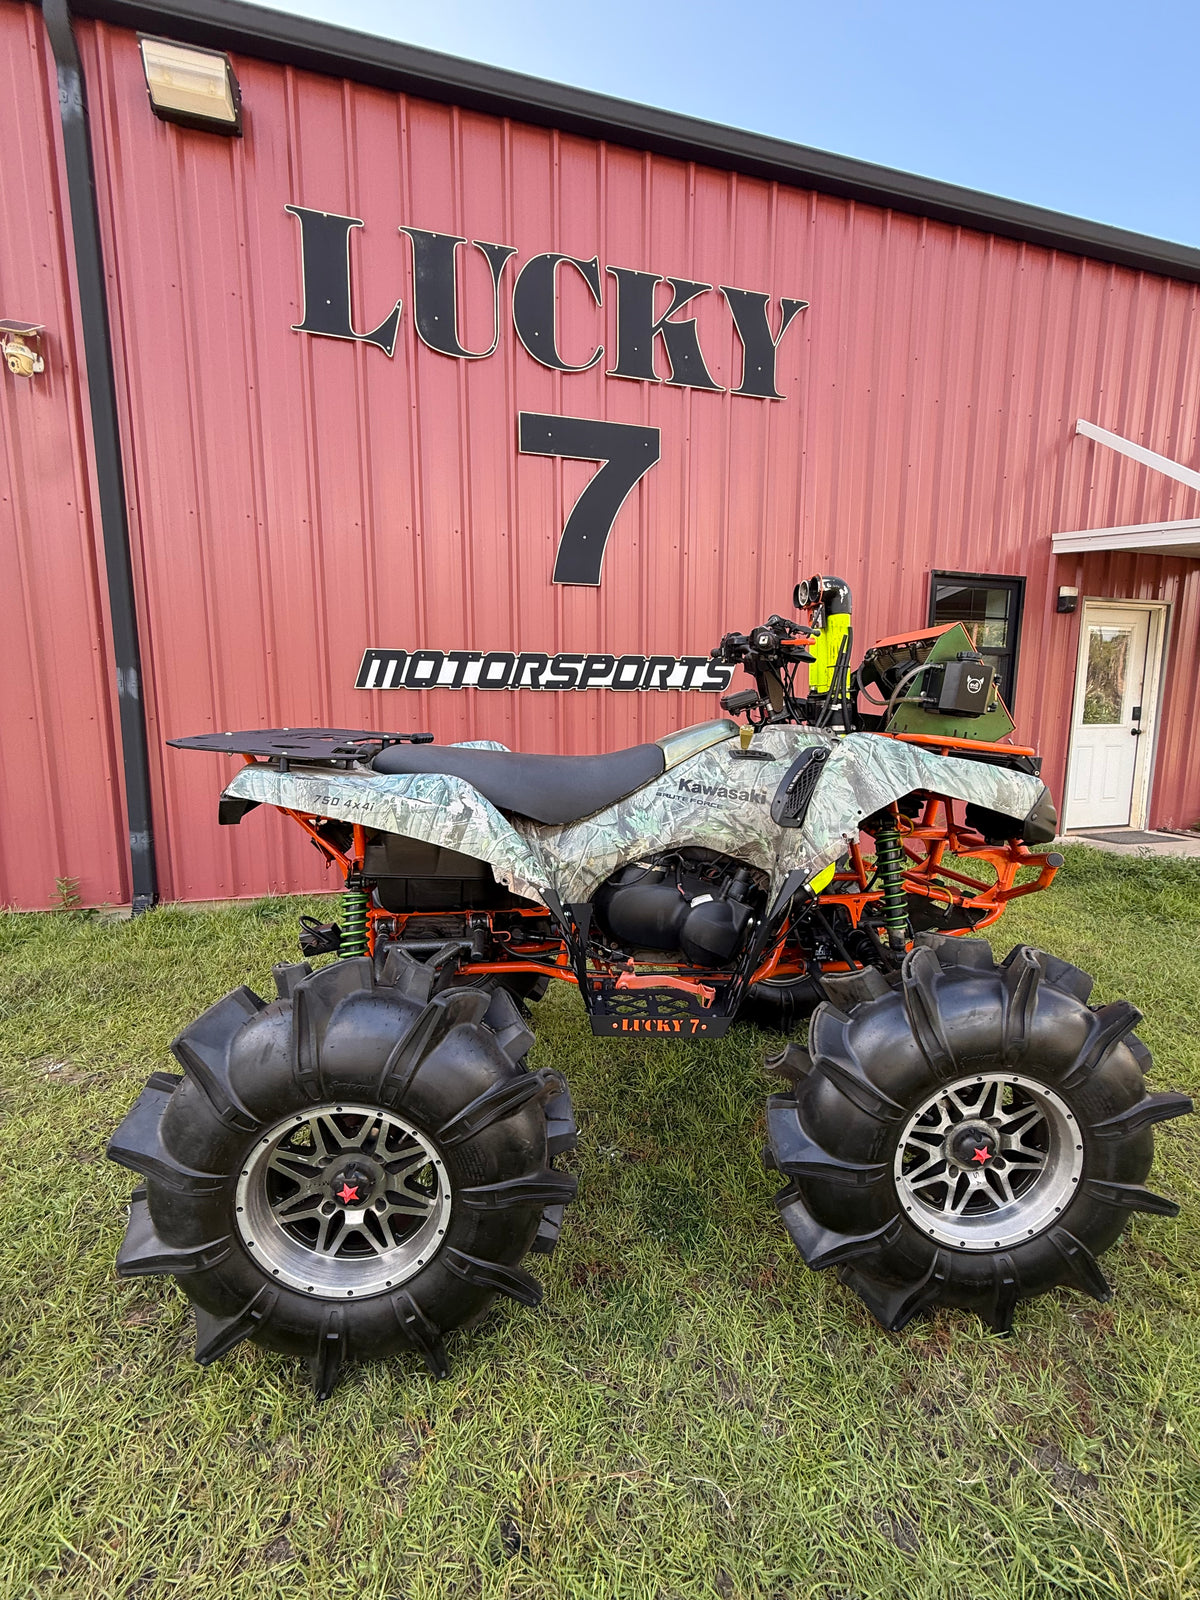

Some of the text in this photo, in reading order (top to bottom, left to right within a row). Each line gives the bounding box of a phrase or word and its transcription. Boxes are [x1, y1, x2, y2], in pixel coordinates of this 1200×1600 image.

[284, 204, 809, 400] LUCKY
[518, 411, 661, 587] 7
[354, 648, 735, 692] MOTORSPORTS
[313, 794, 375, 811] 750 4x4i
[655, 791, 723, 810] BRUTE FORCE
[678, 778, 767, 804] Kawasaki
[622, 1018, 700, 1034] LUCKY 7
